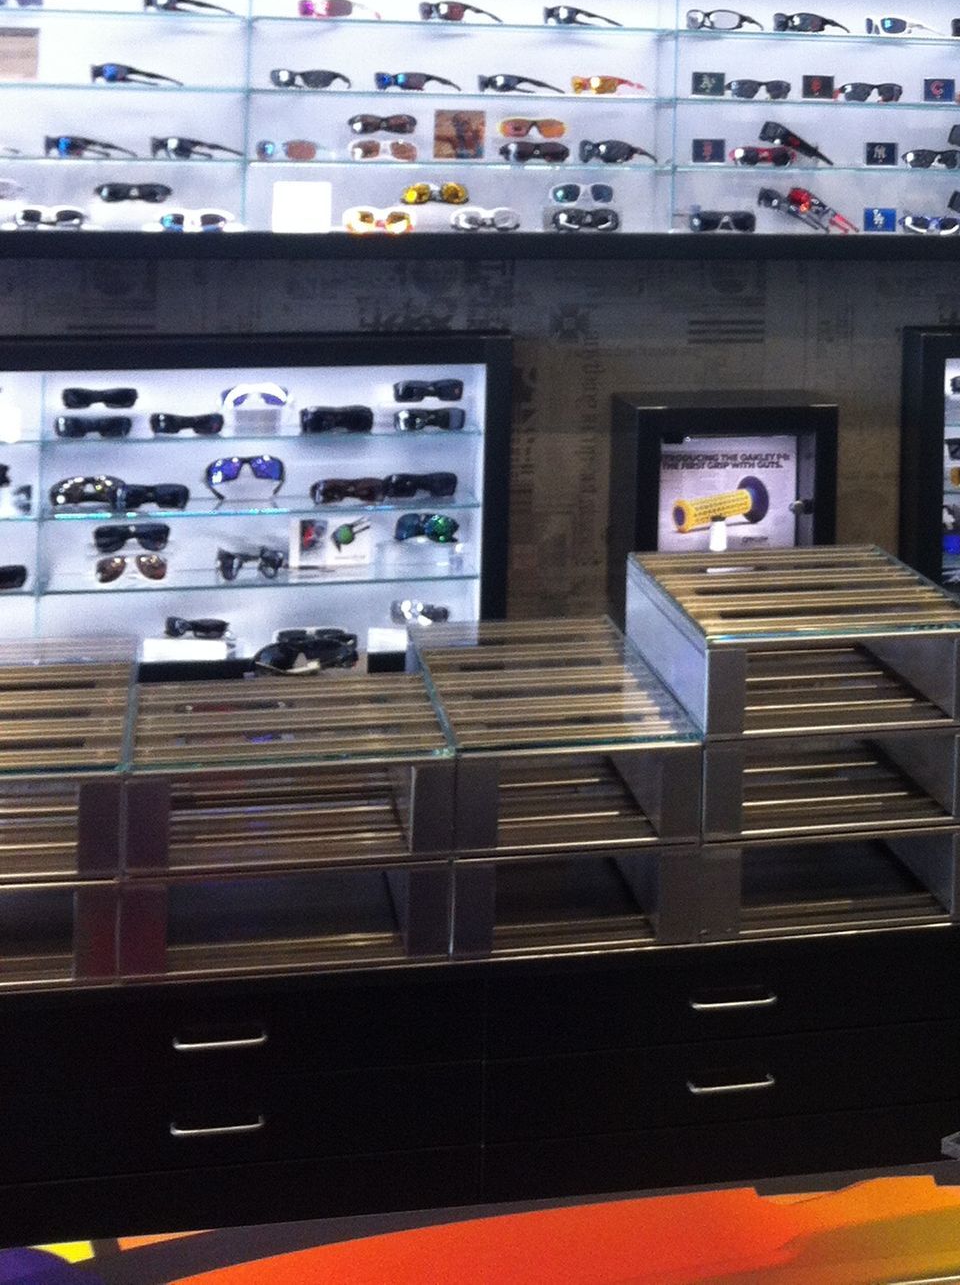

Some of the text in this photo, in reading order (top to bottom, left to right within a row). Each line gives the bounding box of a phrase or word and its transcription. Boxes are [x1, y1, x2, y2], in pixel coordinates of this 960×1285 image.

[740, 453, 776, 461] OAKLEY
[707, 461, 729, 470] GRIP
[731, 461, 755, 469] WITH
